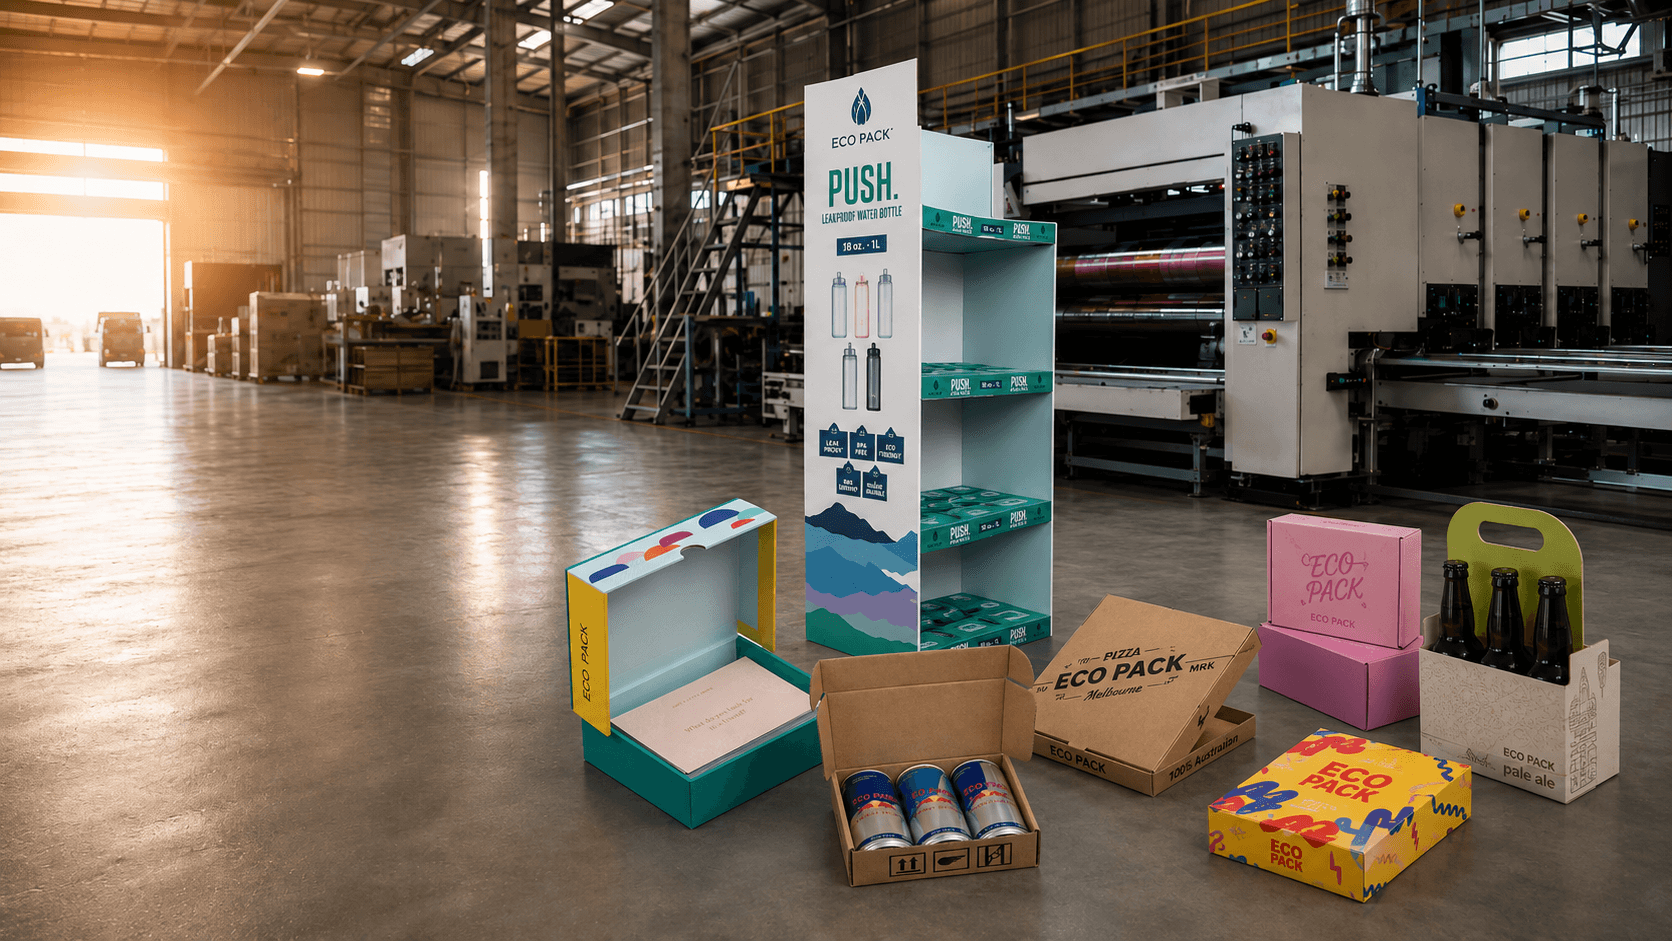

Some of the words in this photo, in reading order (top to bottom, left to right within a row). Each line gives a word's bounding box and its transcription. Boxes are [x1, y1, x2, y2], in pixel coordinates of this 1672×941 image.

[831, 134, 856, 149] ECO
[859, 128, 891, 145] PACK
[828, 161, 899, 208] PUSH.
[821, 211, 856, 225] LEAKPROOF
[857, 208, 878, 221] WATER
[879, 205, 903, 219] BOTTLE
[952, 215, 973, 230] PUSH.
[950, 378, 971, 392] PUSH.
[950, 524, 971, 540] PUSH.
[1301, 551, 1362, 578] ECO
[1306, 576, 1363, 604] PACK
[1310, 612, 1329, 624] ECO
[1331, 616, 1355, 629] PACK
[579, 622, 589, 665] PACK
[1103, 647, 1141, 661] PIZZA
[1054, 667, 1107, 690] ECO
[1112, 653, 1187, 681] PACK
[1189, 661, 1215, 673] MRK
[582, 669, 591, 702] ECO
[1083, 685, 1143, 702] Melbourne
[1050, 744, 1073, 762] ECO
[1075, 754, 1106, 775] PACK
[1194, 734, 1239, 767] Australian
[1503, 747, 1525, 762] ECO
[1527, 754, 1556, 772] PACK
[1317, 760, 1393, 789] ECO
[1503, 764, 1532, 781] pale
[1535, 774, 1556, 790] ale
[1298, 773, 1380, 804] PACK
[1270, 838, 1303, 860] ECO
[1270, 852, 1304, 873] PACK
